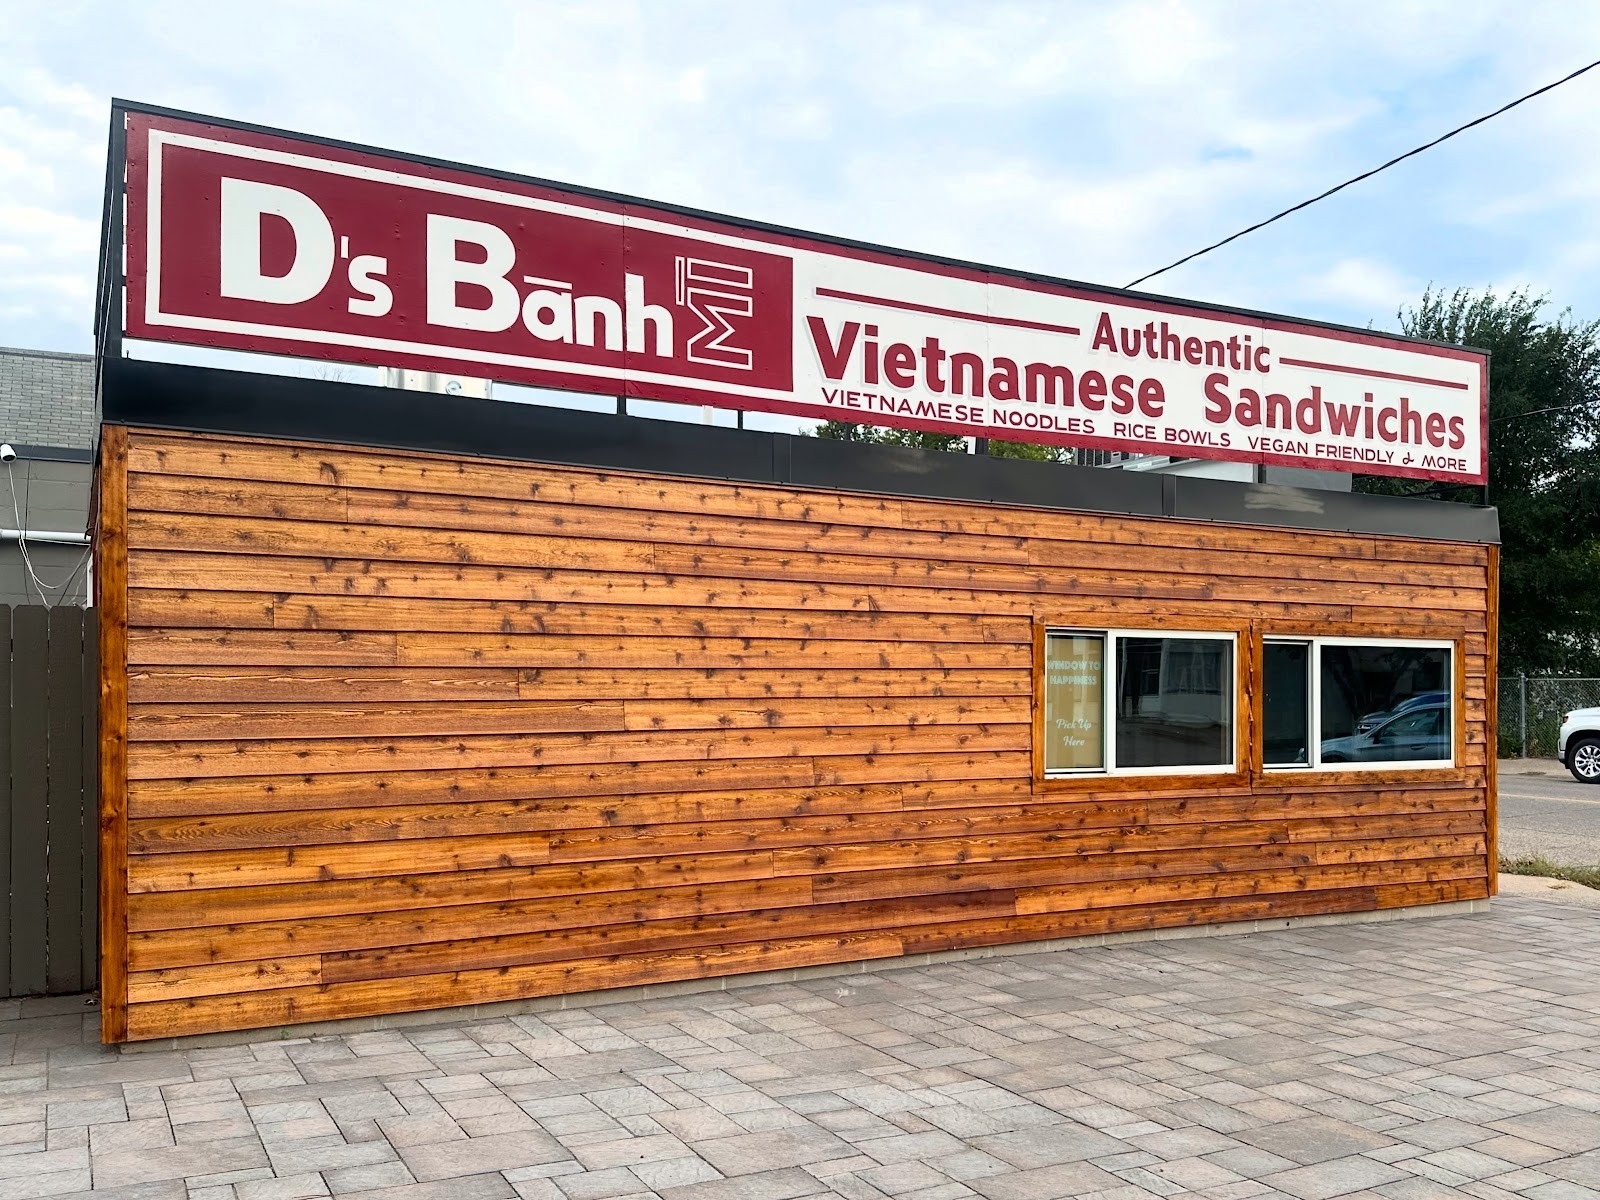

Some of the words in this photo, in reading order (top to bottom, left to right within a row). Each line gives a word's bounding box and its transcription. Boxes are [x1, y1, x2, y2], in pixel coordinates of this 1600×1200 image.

[220, 176, 393, 317] D's
[1091, 311, 1270, 373] Authentic
[806, 315, 1165, 418] Vietnamese
[1204, 372, 1465, 450] Sandwiches
[821, 387, 984, 424] VIETNAMESE
[993, 409, 1095, 434] NOODLES
[1114, 422, 1157, 440] RICE
[1164, 428, 1231, 447] BOWLS
[1248, 435, 1308, 455] VEGAN
[1315, 443, 1394, 464] FRIENDLY
[1402, 451, 1415, 465] &
[1421, 454, 1467, 471] MORE
[1047, 660, 1088, 671] WINDOW
[1089, 660, 1101, 671] TO
[1049, 675, 1097, 686] HAPPINESS
[1056, 718, 1077, 729] Pick
[1078, 718, 1092, 732] Up
[1063, 735, 1086, 746] Here
